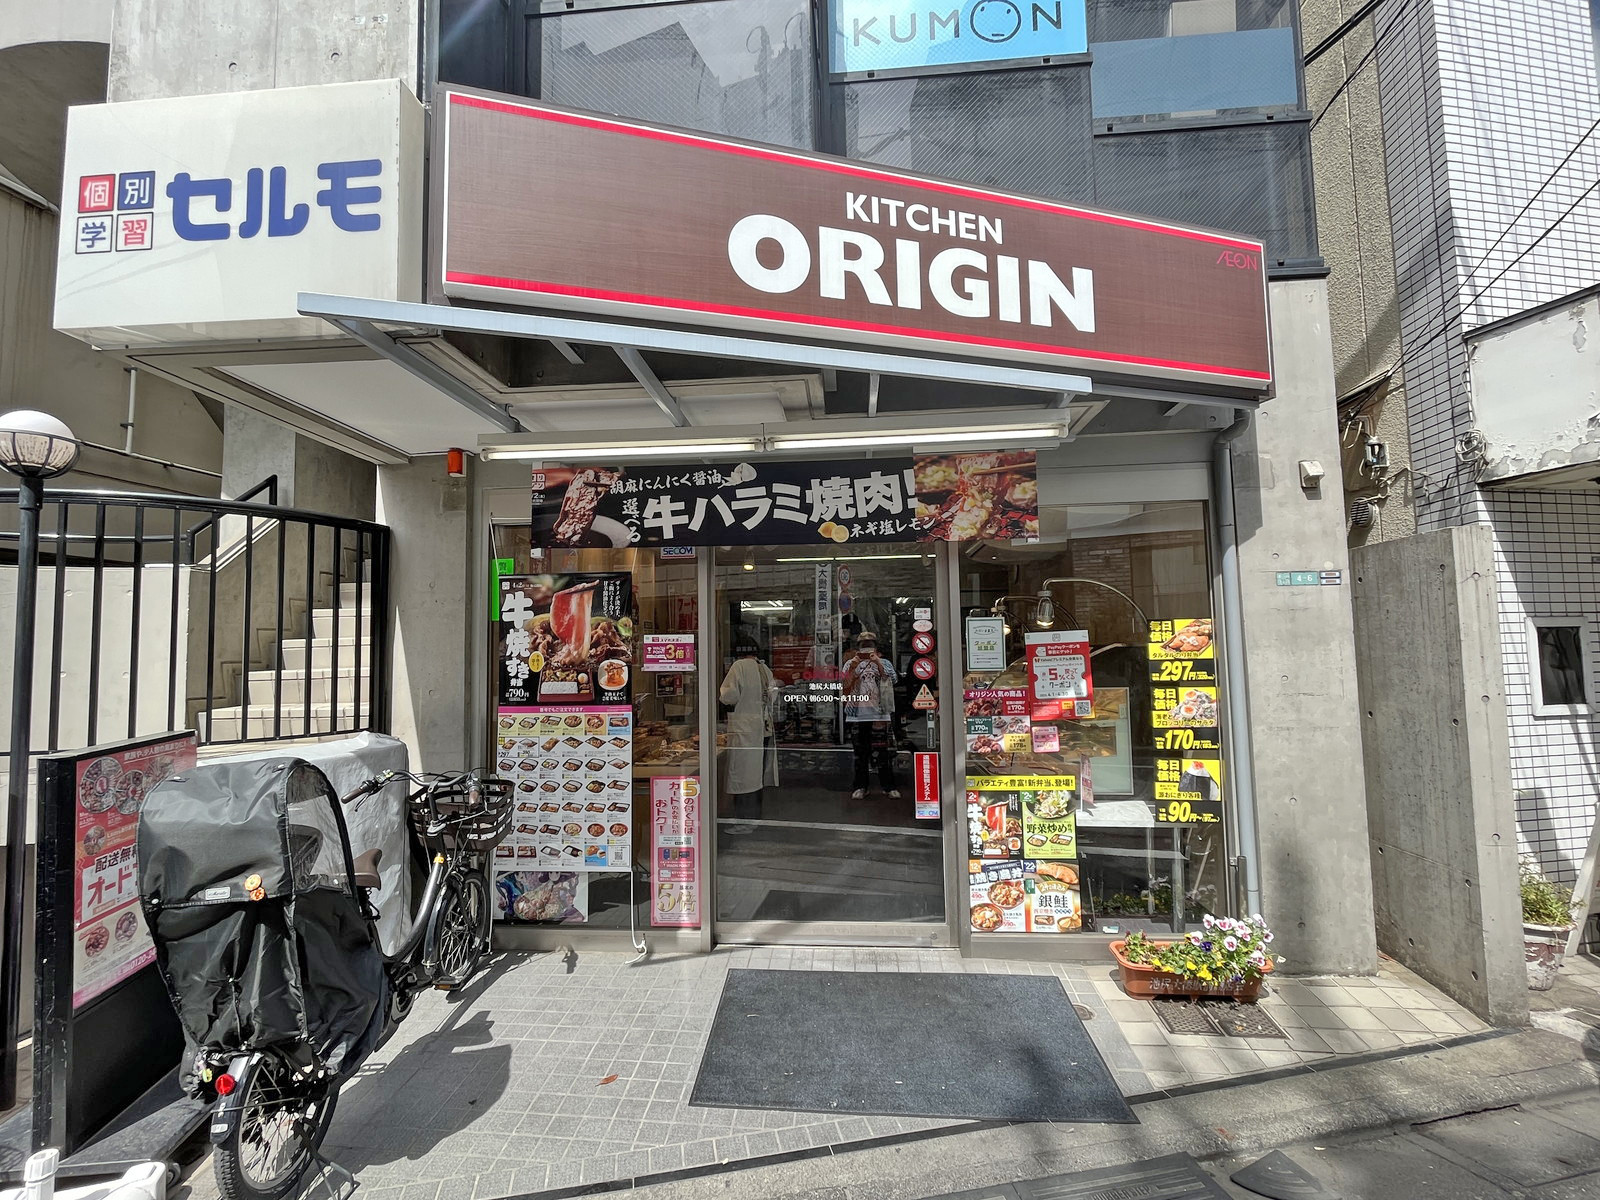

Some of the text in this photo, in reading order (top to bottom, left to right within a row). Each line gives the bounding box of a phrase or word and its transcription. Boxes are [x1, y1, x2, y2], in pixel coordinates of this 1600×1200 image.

[854, 0, 1063, 47] KUMON
[83, 175, 150, 209] 個別
[165, 159, 383, 241] セルモ
[846, 191, 1004, 245] KITCHEN
[80, 219, 150, 249] 学習
[727, 214, 1097, 334] ORIGIN
[662, 546, 694, 556] SECOM
[1149, 620, 1172, 631] 毎日
[1149, 631, 1173, 642] 価格
[1153, 688, 1177, 699] 毎日
[1153, 699, 1178, 710] 価格
[1156, 759, 1180, 770] 毎日
[1156, 770, 1181, 782] 価格
[1026, 823, 1068, 834] 野菜炒め
[87, 862, 138, 908] オード
[1038, 894, 1069, 908] 銀鮭
